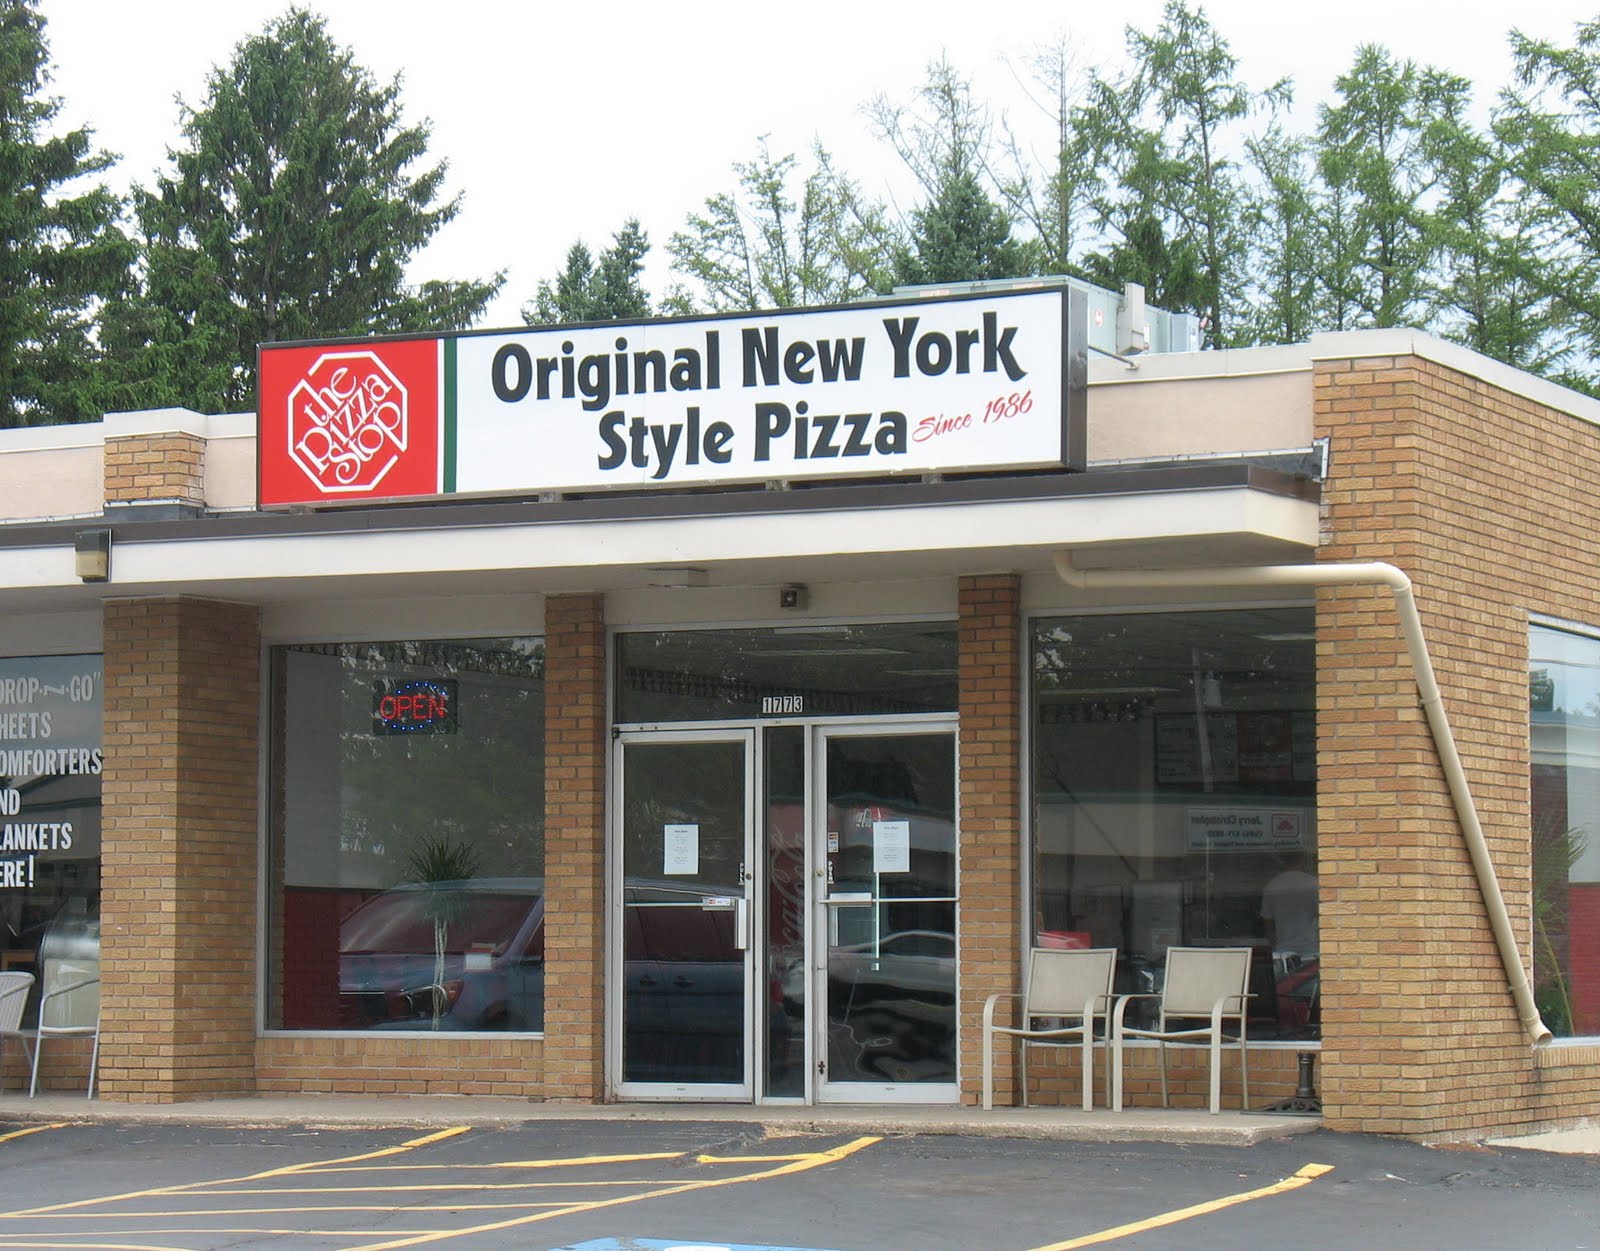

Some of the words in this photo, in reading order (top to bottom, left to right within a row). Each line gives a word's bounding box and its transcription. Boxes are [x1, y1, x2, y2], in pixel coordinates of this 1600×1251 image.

[492, 330, 720, 411] Original
[741, 326, 866, 387] New
[882, 311, 1029, 382] York
[304, 366, 357, 427] the
[598, 406, 735, 479] Style
[753, 401, 908, 462] Pizza
[911, 412, 974, 443] Since
[983, 389, 1034, 424] 1986
[380, 694, 446, 721] OPEN
[763, 696, 803, 713] 1773
[0, 822, 73, 850] ANKETS
